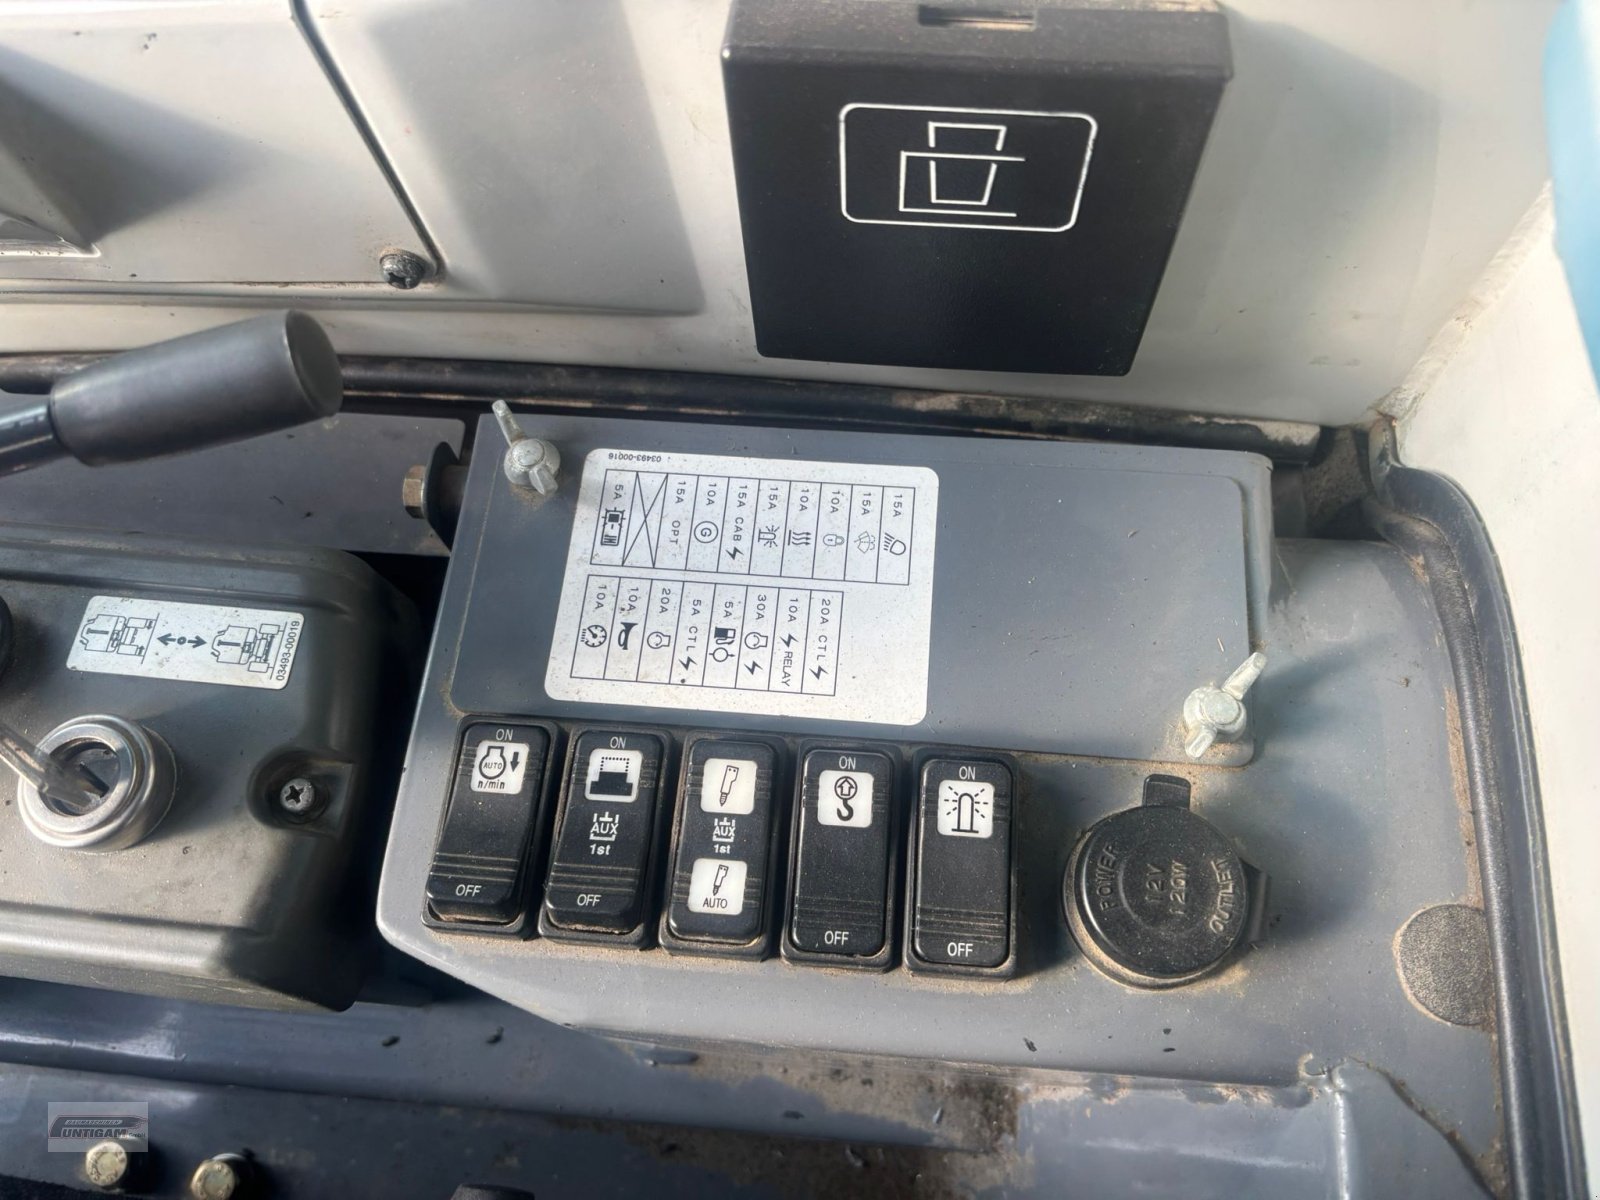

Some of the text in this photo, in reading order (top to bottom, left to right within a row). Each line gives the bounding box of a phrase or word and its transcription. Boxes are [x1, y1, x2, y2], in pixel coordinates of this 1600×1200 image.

[613, 484, 624, 500] 5A
[705, 483, 717, 506] 10A
[767, 487, 779, 510] 15A
[799, 489, 810, 512] 10A
[830, 490, 841, 514] 10A
[669, 480, 687, 545] 15A OPT
[732, 485, 748, 542] 15A CAB
[861, 492, 872, 516] 15A
[892, 494, 903, 518] 15A
[595, 585, 607, 610] 10A
[627, 586, 639, 612] 10A
[659, 587, 671, 614] 20A
[755, 594, 767, 621] 30A
[723, 601, 734, 618] 5A
[686, 599, 702, 652] 5A CTL
[816, 598, 831, 661] 20A CTL
[275, 620, 300, 681] 03493-00019
[781, 598, 799, 687] 10A RELAY
[495, 728, 514, 741] ON
[609, 736, 627, 749] ON
[482, 762, 503, 770] AUTO
[839, 756, 856, 770] ON
[959, 766, 976, 780] ON
[477, 779, 506, 790] n/min
[590, 822, 619, 835] AUX
[712, 826, 736, 837] AUX
[589, 843, 611, 855] 1st
[713, 844, 731, 854] 1st
[455, 884, 482, 897] OFF
[576, 894, 602, 907] OFF
[1209, 857, 1235, 934] OUTLET
[702, 897, 728, 909] AUTO
[824, 931, 849, 946] OFF
[947, 942, 974, 957] OFF
